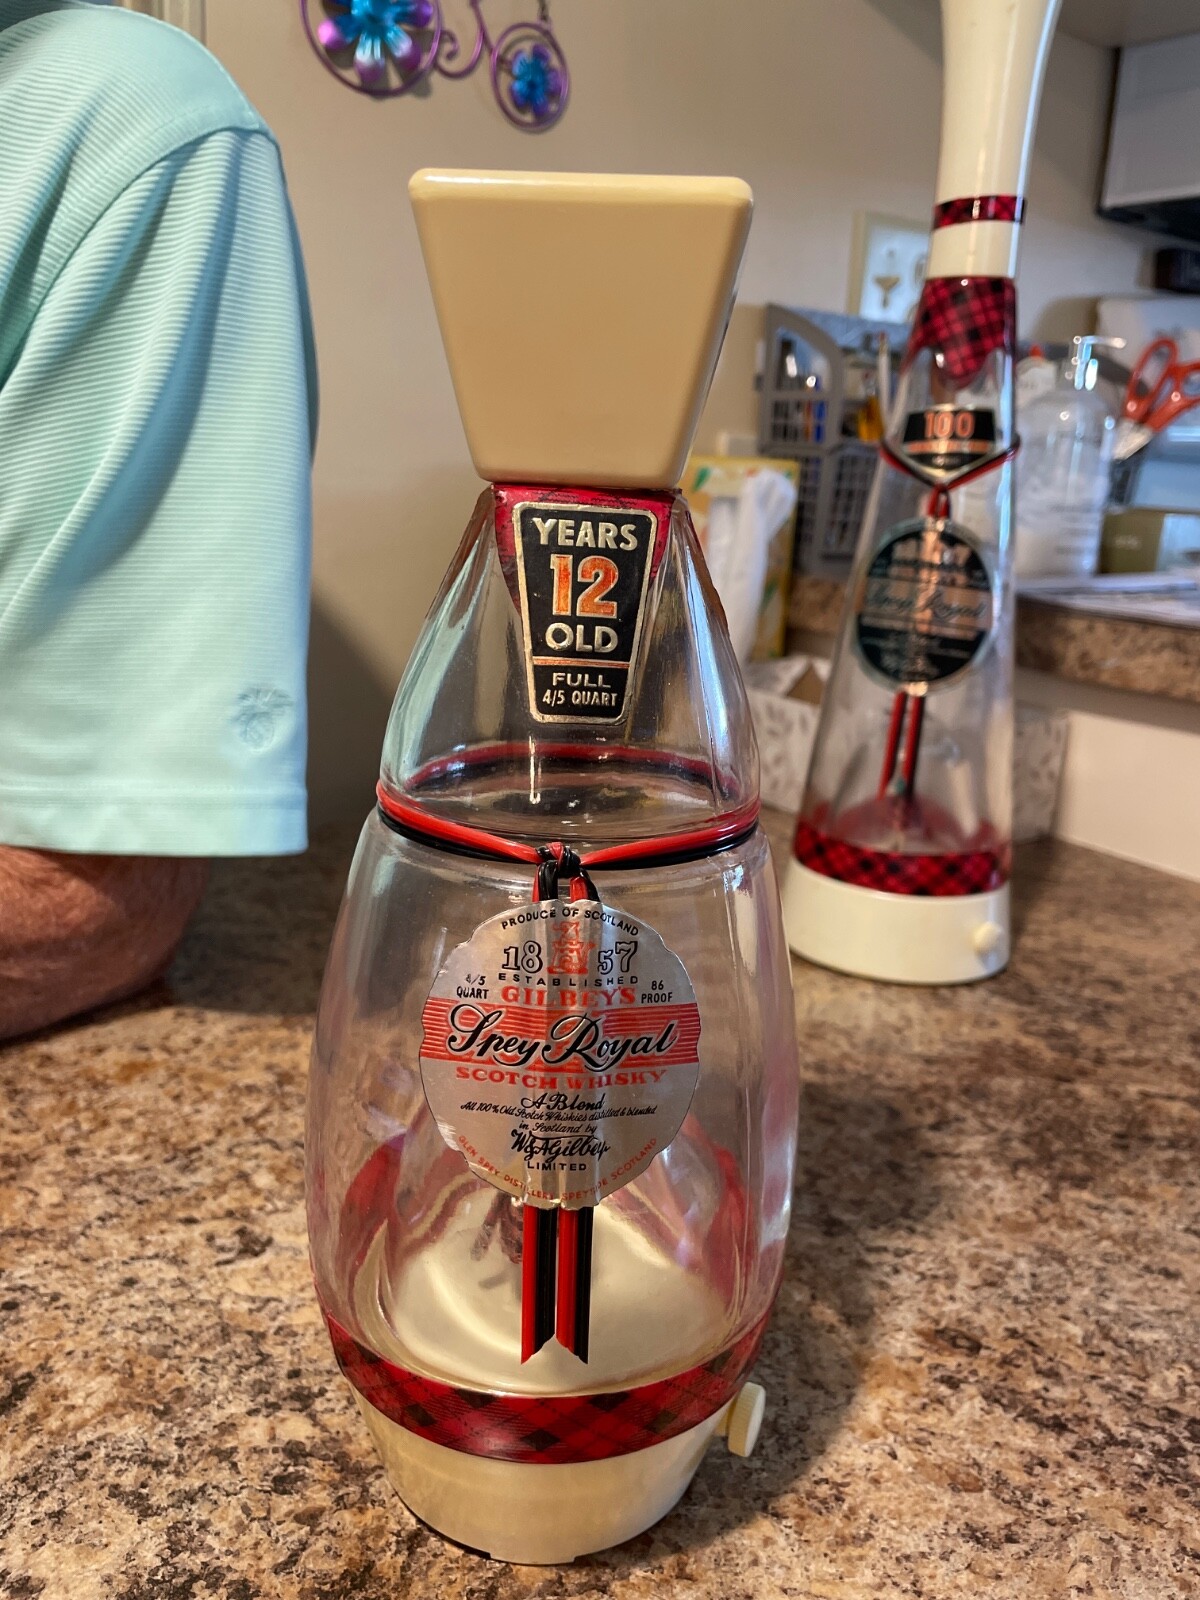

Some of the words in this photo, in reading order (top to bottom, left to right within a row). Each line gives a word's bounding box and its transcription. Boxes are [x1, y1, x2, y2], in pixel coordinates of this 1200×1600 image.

[923, 410, 976, 440] 100
[532, 517, 638, 551] YEARS
[550, 553, 619, 619] 12
[545, 622, 619, 653] OLD
[552, 672, 611, 688] FULL
[542, 689, 565, 707] 4/5
[571, 690, 618, 707] QUART
[501, 908, 556, 930] PRODUCE
[561, 907, 579, 918] OF
[584, 909, 639, 936] SCOTLAND
[501, 940, 544, 974] 18
[597, 940, 638, 975] 57
[498, 972, 639, 987] ESTABLISHED
[650, 980, 664, 991] 86
[456, 985, 490, 1000] QUART
[501, 984, 636, 1008] GILBEY'S
[640, 991, 673, 1004] PROOF
[447, 1003, 541, 1067] Spey
[541, 1011, 677, 1073] Royal
[455, 1066, 558, 1090] SCOTCH
[567, 1069, 668, 1090] WHISKY
[460, 1101, 478, 1111] All
[499, 1105, 517, 1116] Old
[514, 1108, 545, 1121] Scotch
[544, 1111, 588, 1123] Whiskies
[625, 1104, 658, 1117] blended
[520, 1092, 549, 1109] A
[546, 1092, 606, 1111] Blend
[518, 1120, 530, 1131] in
[532, 1122, 582, 1134] Scotland
[584, 1124, 598, 1136] by
[458, 1135, 478, 1157] GLEN
[478, 1156, 501, 1176] SPEY
[610, 1137, 657, 1181] SCOTLAND
[527, 1160, 587, 1171] LIMITED
